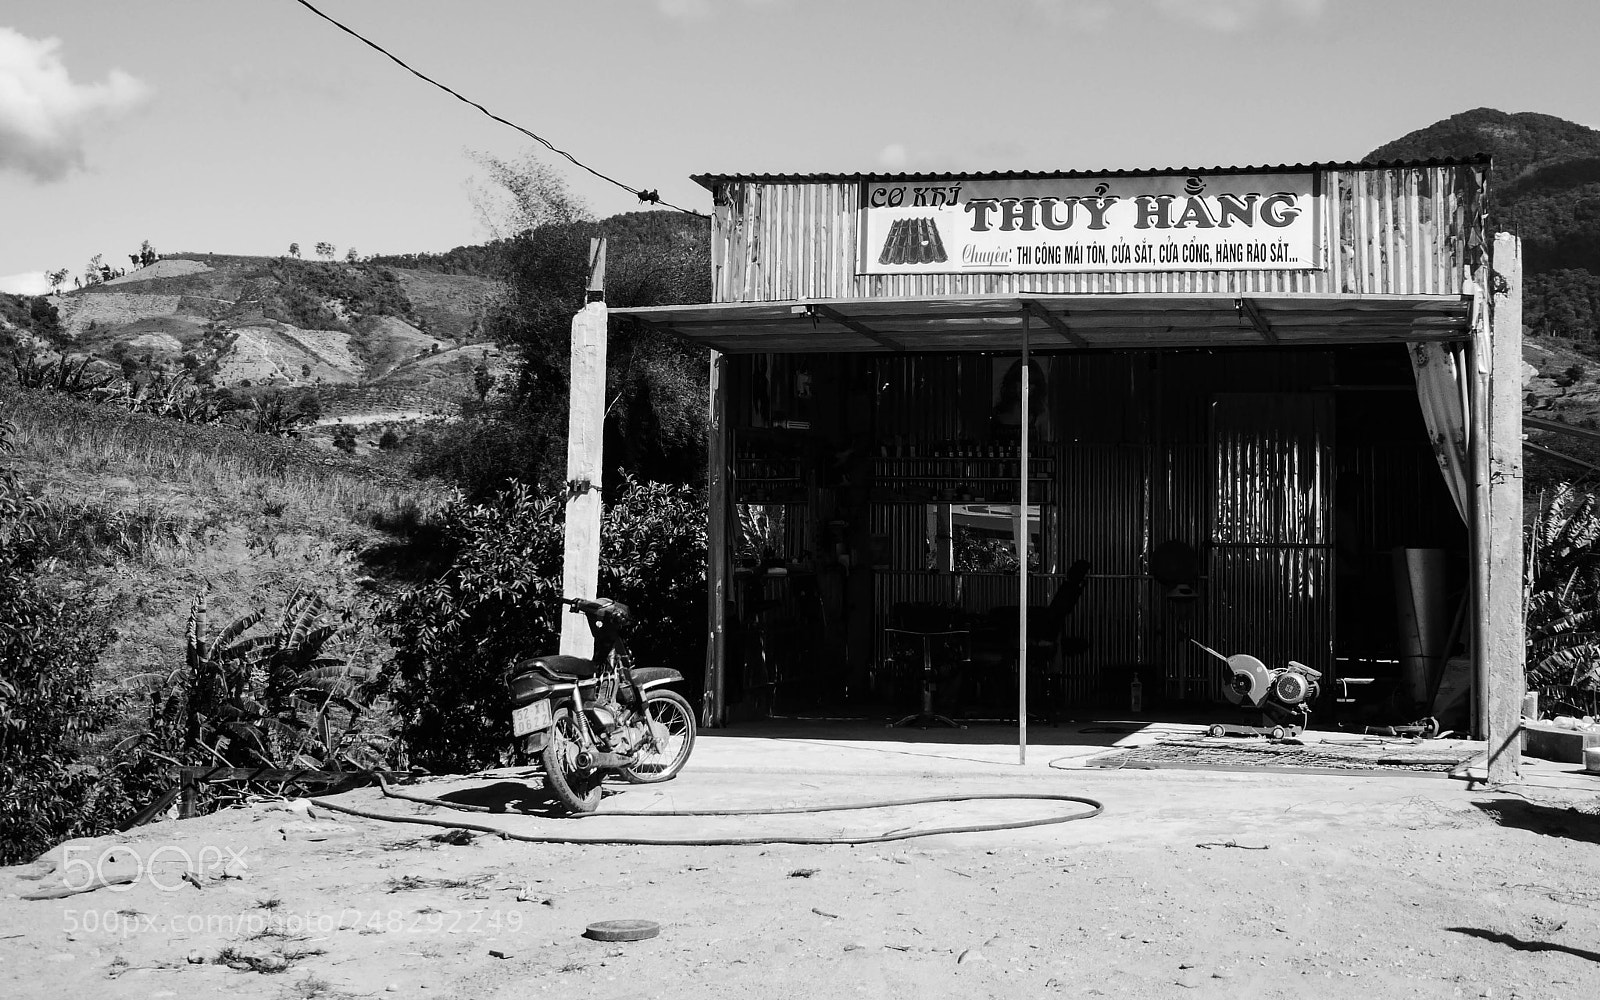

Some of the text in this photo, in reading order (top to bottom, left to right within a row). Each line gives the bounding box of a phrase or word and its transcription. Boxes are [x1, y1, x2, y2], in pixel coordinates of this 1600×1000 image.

[1017, 246, 1032, 265] THI
[1034, 241, 1061, 265] CÔNG
[1064, 240, 1083, 264] MÁI
[1086, 240, 1108, 266] TÔN,
[1111, 236, 1131, 263] CỬA
[1134, 237, 1156, 265] SẮT,
[1159, 235, 1179, 263] CỬA
[1182, 235, 1213, 265] CỔNG,
[1216, 239, 1243, 263] HÀNG
[1246, 239, 1267, 263] RÀO
